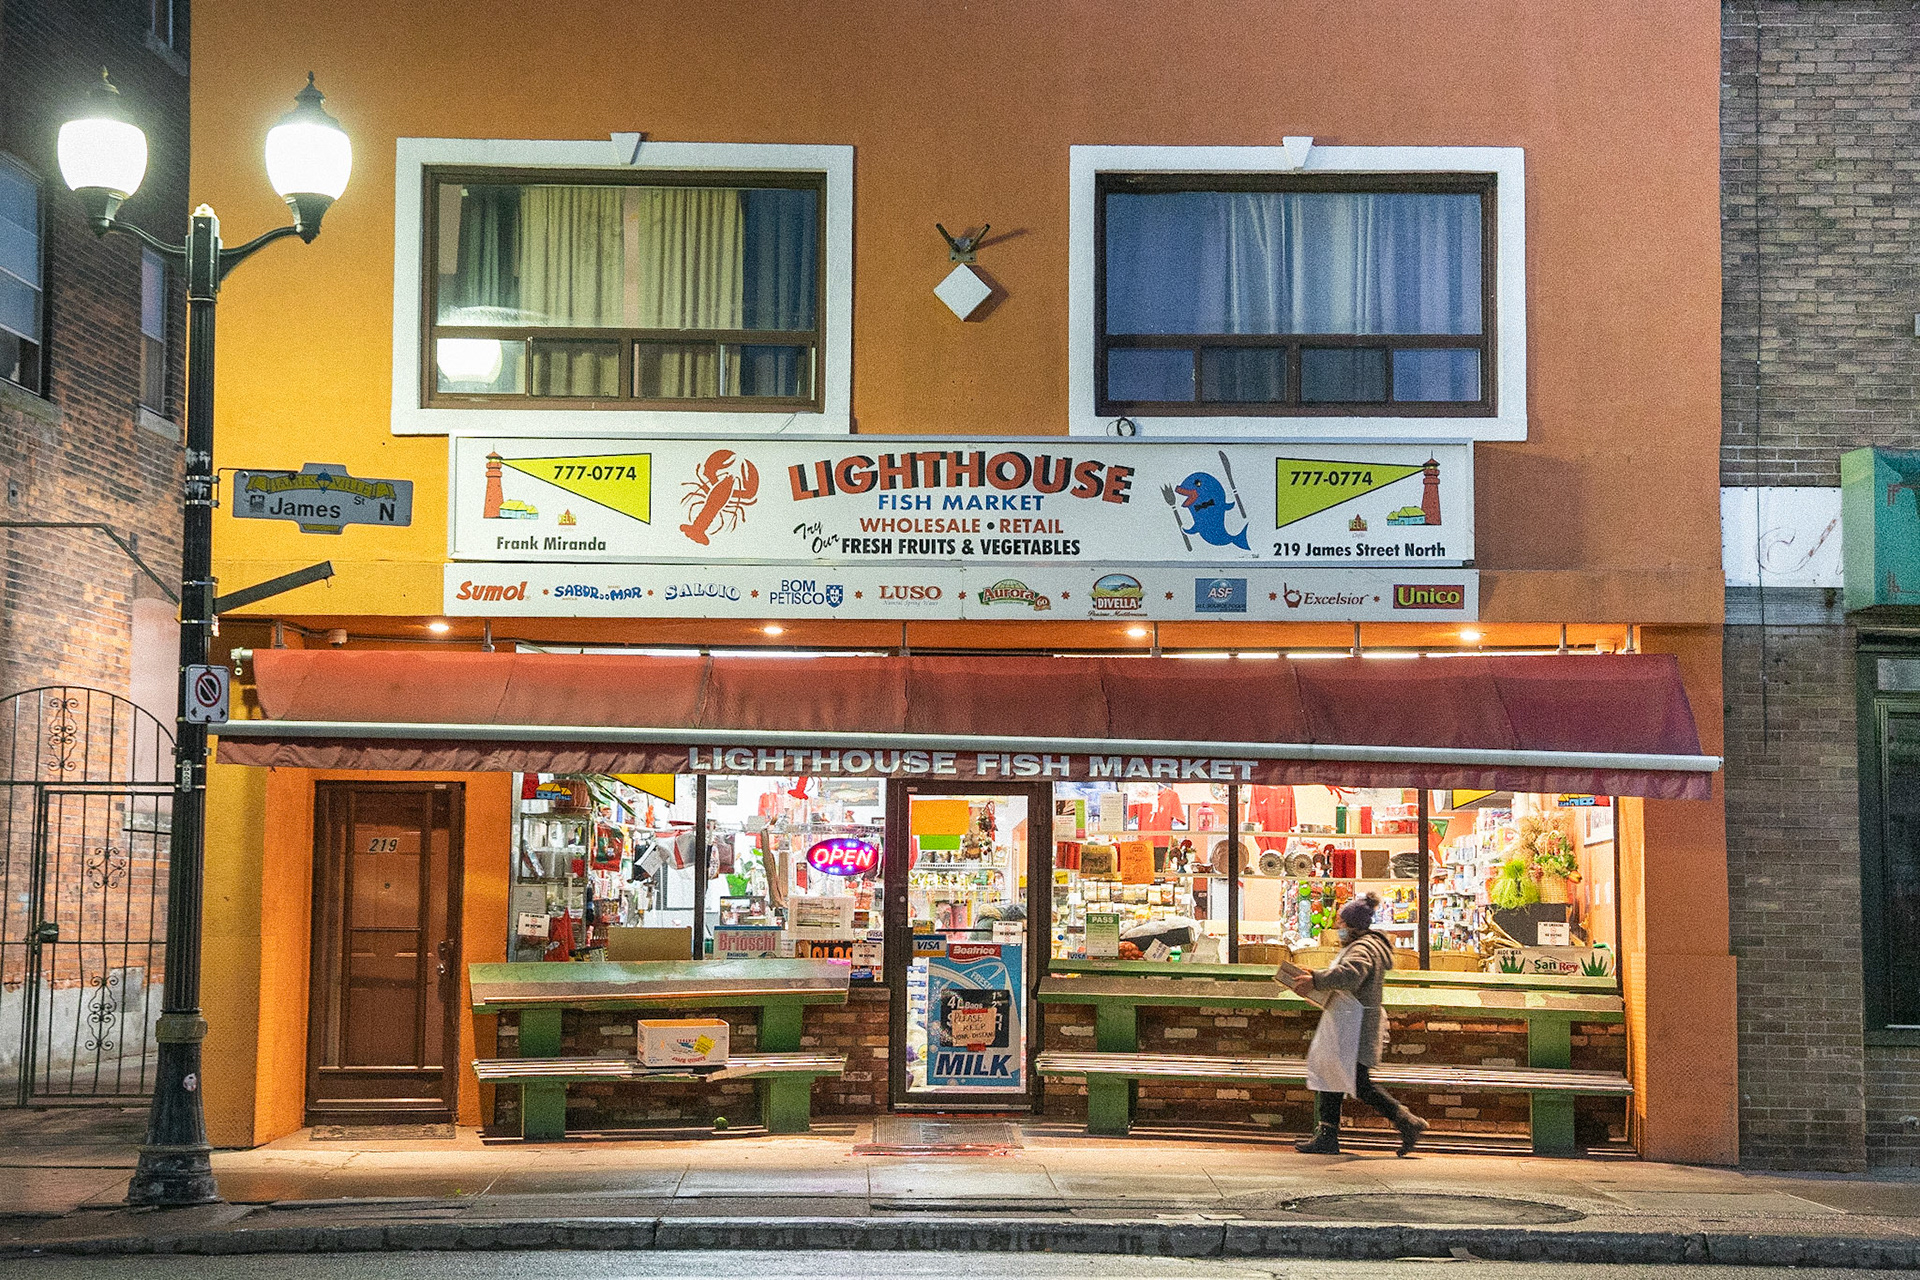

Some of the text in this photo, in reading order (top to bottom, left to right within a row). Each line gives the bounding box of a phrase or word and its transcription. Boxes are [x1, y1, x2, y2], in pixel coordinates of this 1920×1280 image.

[554, 465, 637, 480] 777-0774
[788, 451, 1135, 504] LIGHTHOUSE
[1291, 471, 1373, 486] 777-0774
[270, 496, 395, 521] James St N
[878, 495, 1044, 511] FISH MARKET
[859, 518, 1064, 534] WHOLESALE RETAIL
[497, 536, 606, 551] Frank Miranda
[793, 521, 841, 554] Try Our
[842, 538, 1080, 556] FRESH FRUITS & VEGETABLES
[1273, 543, 1301, 557] 219
[1305, 543, 1351, 557] James
[1356, 543, 1401, 557] Street
[1405, 543, 1446, 557] North
[456, 580, 528, 601] Sumol
[554, 584, 599, 600] SABOR
[610, 586, 643, 601] MAR
[664, 582, 741, 602] SALOIO
[781, 579, 816, 593] BOM
[878, 585, 943, 600] LUSO
[1207, 587, 1233, 598] ASF
[769, 592, 825, 605] PETISCO
[983, 587, 1035, 601] Aurora
[1303, 592, 1369, 605] Excelsior
[1398, 587, 1460, 606] Unico
[1097, 598, 1137, 609] DIVELLA
[688, 747, 1258, 780] LIGHTHOUSE FISH MARKET
[368, 838, 398, 852] 219
[813, 848, 873, 866] OPEN
[1091, 916, 1114, 924] PASS
[718, 931, 776, 951] Brioschi
[917, 941, 940, 950] VISA
[953, 945, 995, 955] Beatrice
[1534, 959, 1579, 973] San Rey
[954, 1012, 982, 1023] PLEASE
[963, 1023, 986, 1031] KEEP
[933, 1053, 1012, 1078] MILK
